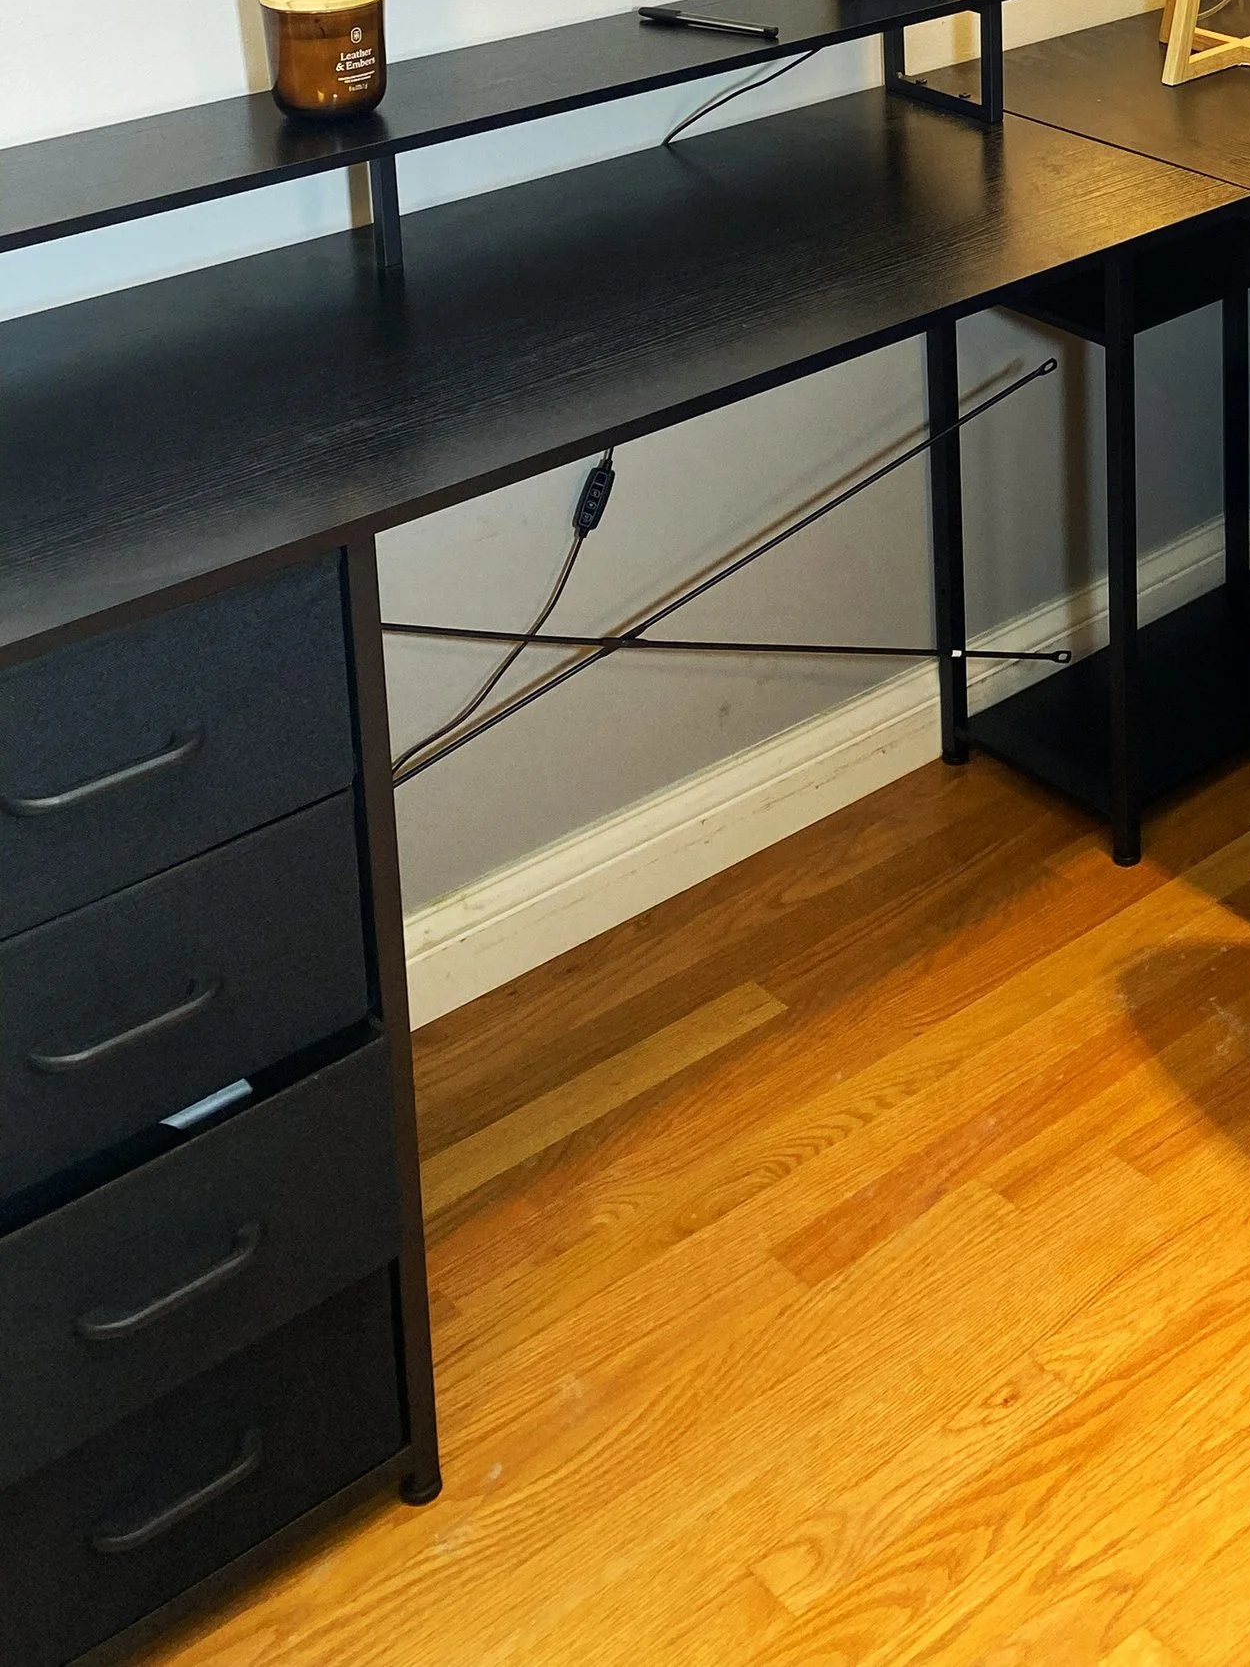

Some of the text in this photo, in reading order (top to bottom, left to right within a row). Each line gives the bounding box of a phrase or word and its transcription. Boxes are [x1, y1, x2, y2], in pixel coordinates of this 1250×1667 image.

[340, 48, 372, 61] Leather
[335, 57, 375, 72] & Embers
